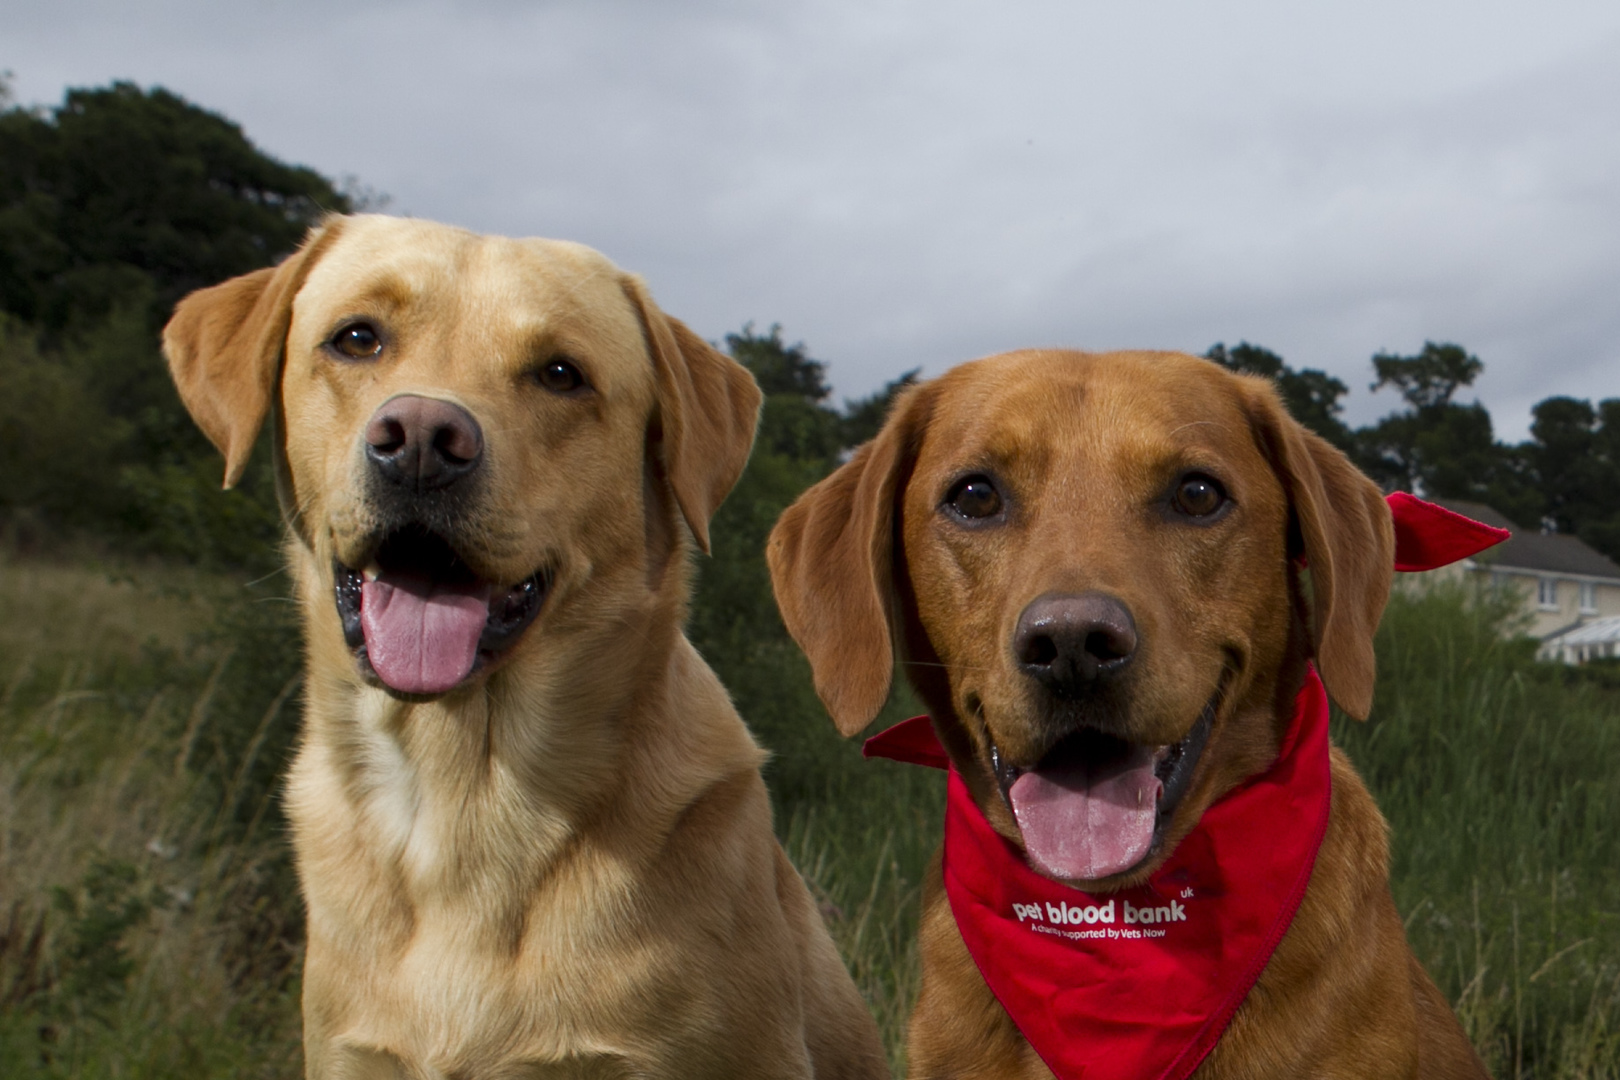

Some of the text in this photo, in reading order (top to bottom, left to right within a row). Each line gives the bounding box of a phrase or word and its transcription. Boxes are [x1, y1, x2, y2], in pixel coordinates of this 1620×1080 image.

[1181, 887, 1194, 898] uk
[1012, 899, 1187, 924] pet blood bank
[1107, 927, 1120, 939] by
[1120, 928, 1141, 939] Vets
[1143, 928, 1165, 938] Now
